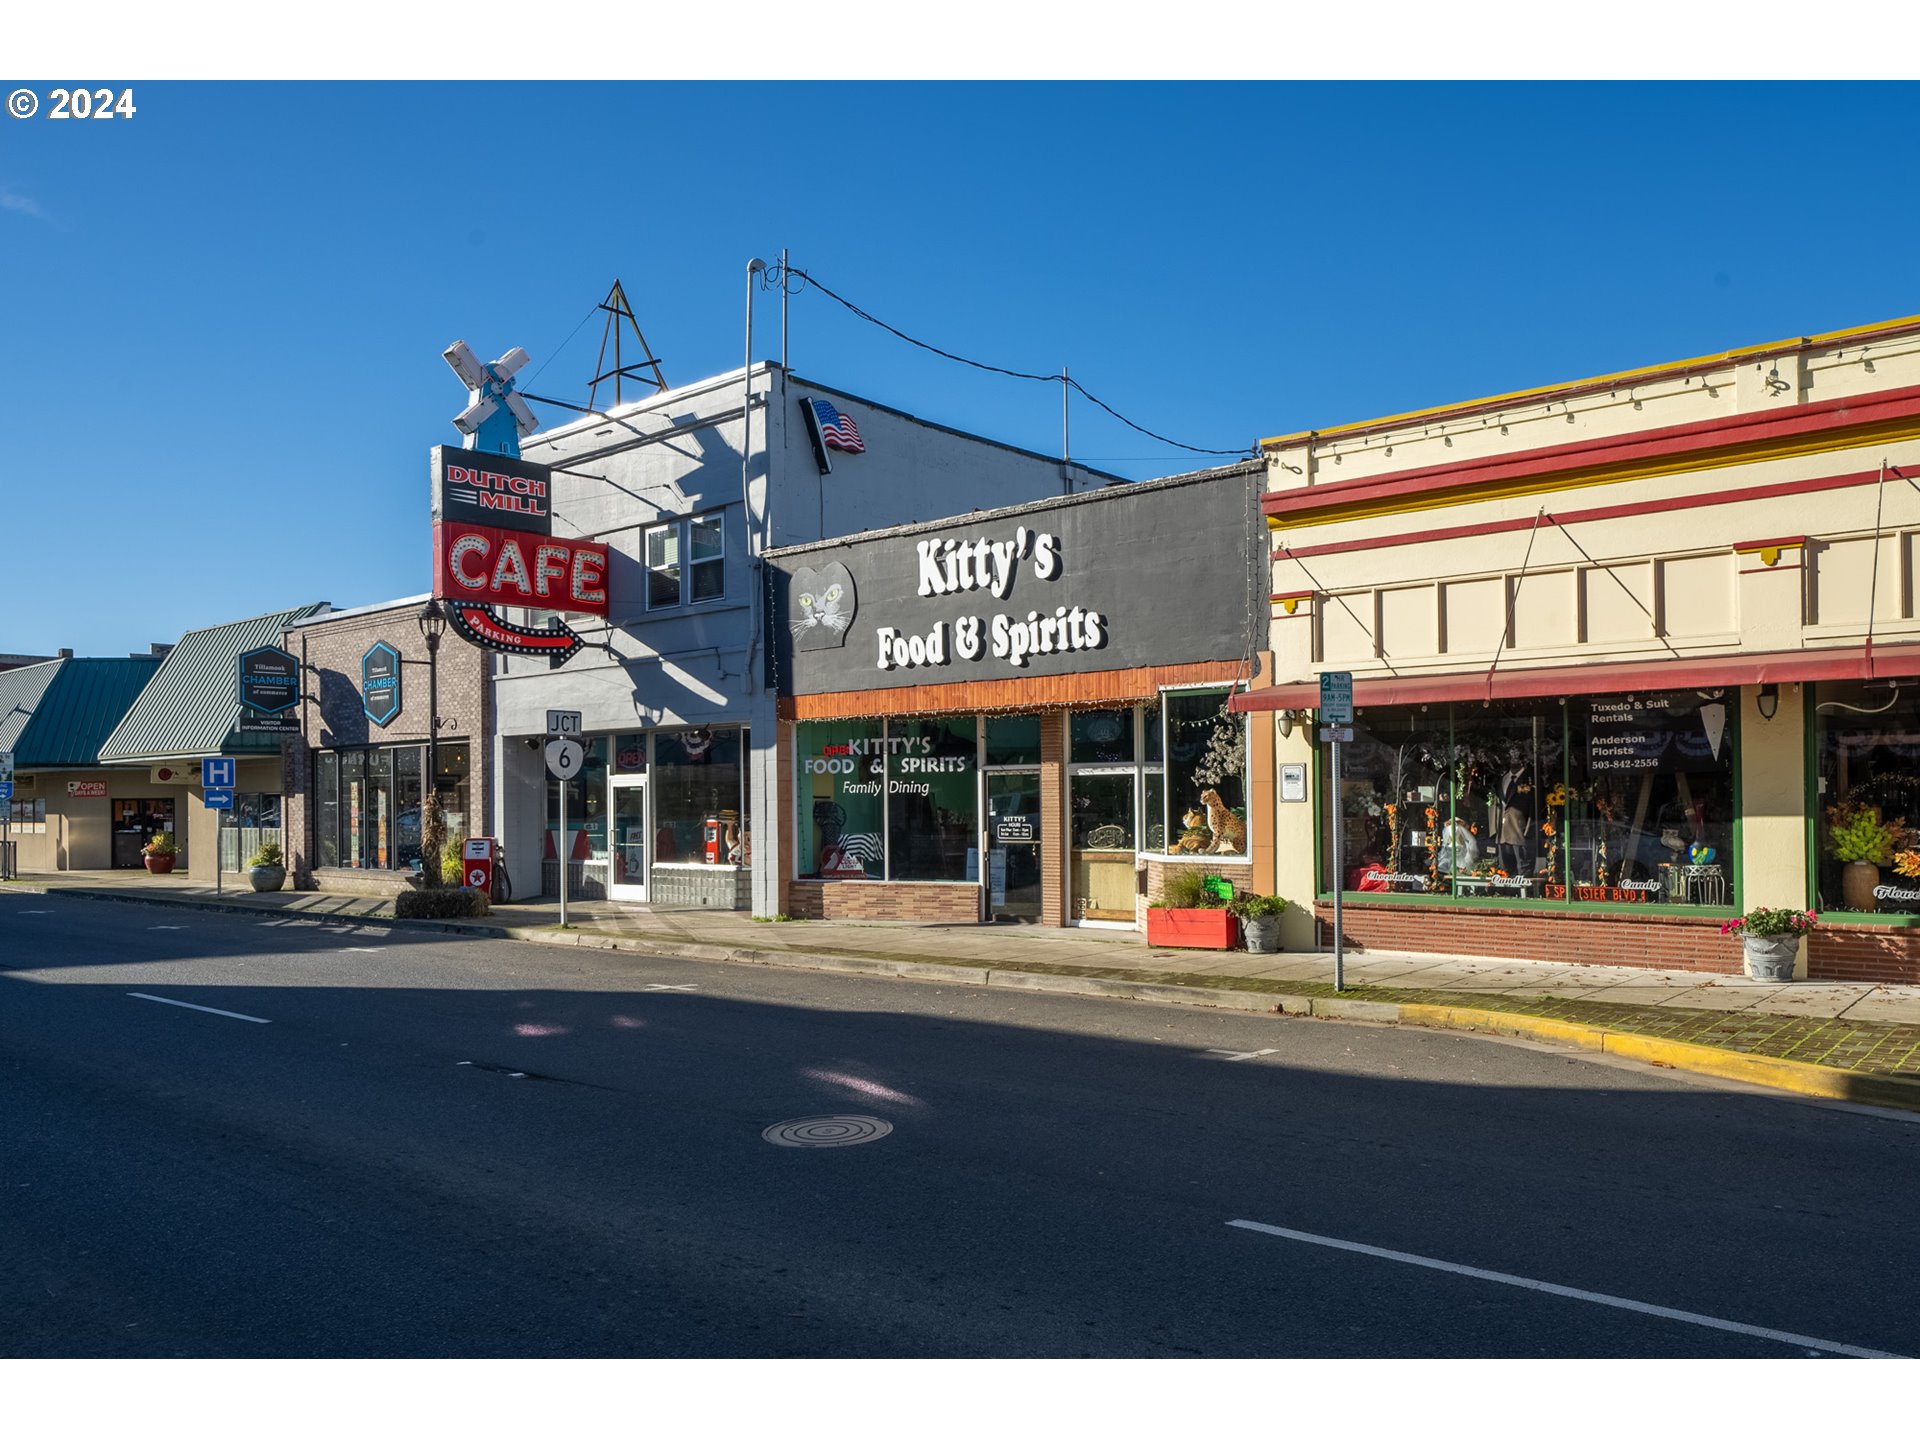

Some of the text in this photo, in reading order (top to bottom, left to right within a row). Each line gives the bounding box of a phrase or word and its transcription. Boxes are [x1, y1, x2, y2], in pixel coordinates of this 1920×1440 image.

[447, 465, 546, 497] DUTCH
[479, 492, 546, 516] MILL
[448, 533, 606, 604] CAFE
[917, 526, 1056, 598] Kitty's
[470, 616, 521, 644] PARKING
[877, 606, 1101, 669] Food & Spirits
[242, 675, 298, 686] CHAMBER
[363, 676, 397, 690] CHAMBER
[1321, 675, 1330, 689] 2
[1591, 699, 1670, 712] Tuxedo & Suit
[551, 715, 578, 732] JCT
[1591, 713, 1634, 723] Rentals
[848, 736, 931, 756] KITTY'S
[1591, 736, 1646, 745] Anderson
[559, 747, 571, 768] 6
[1592, 747, 1635, 756] Florists
[804, 756, 966, 775] FOOD & SPIRITS
[1592, 758, 1659, 770] 503-842-2556
[209, 762, 229, 783] H
[80, 782, 105, 790] OPEN
[842, 780, 930, 796] Family Dining
[1367, 871, 1415, 882] Chocolates
[1491, 874, 1532, 887] Candles
[1620, 878, 1661, 892] Candy
[1612, 888, 1636, 901] BLVD
[1873, 885, 1920, 900] Flowe
